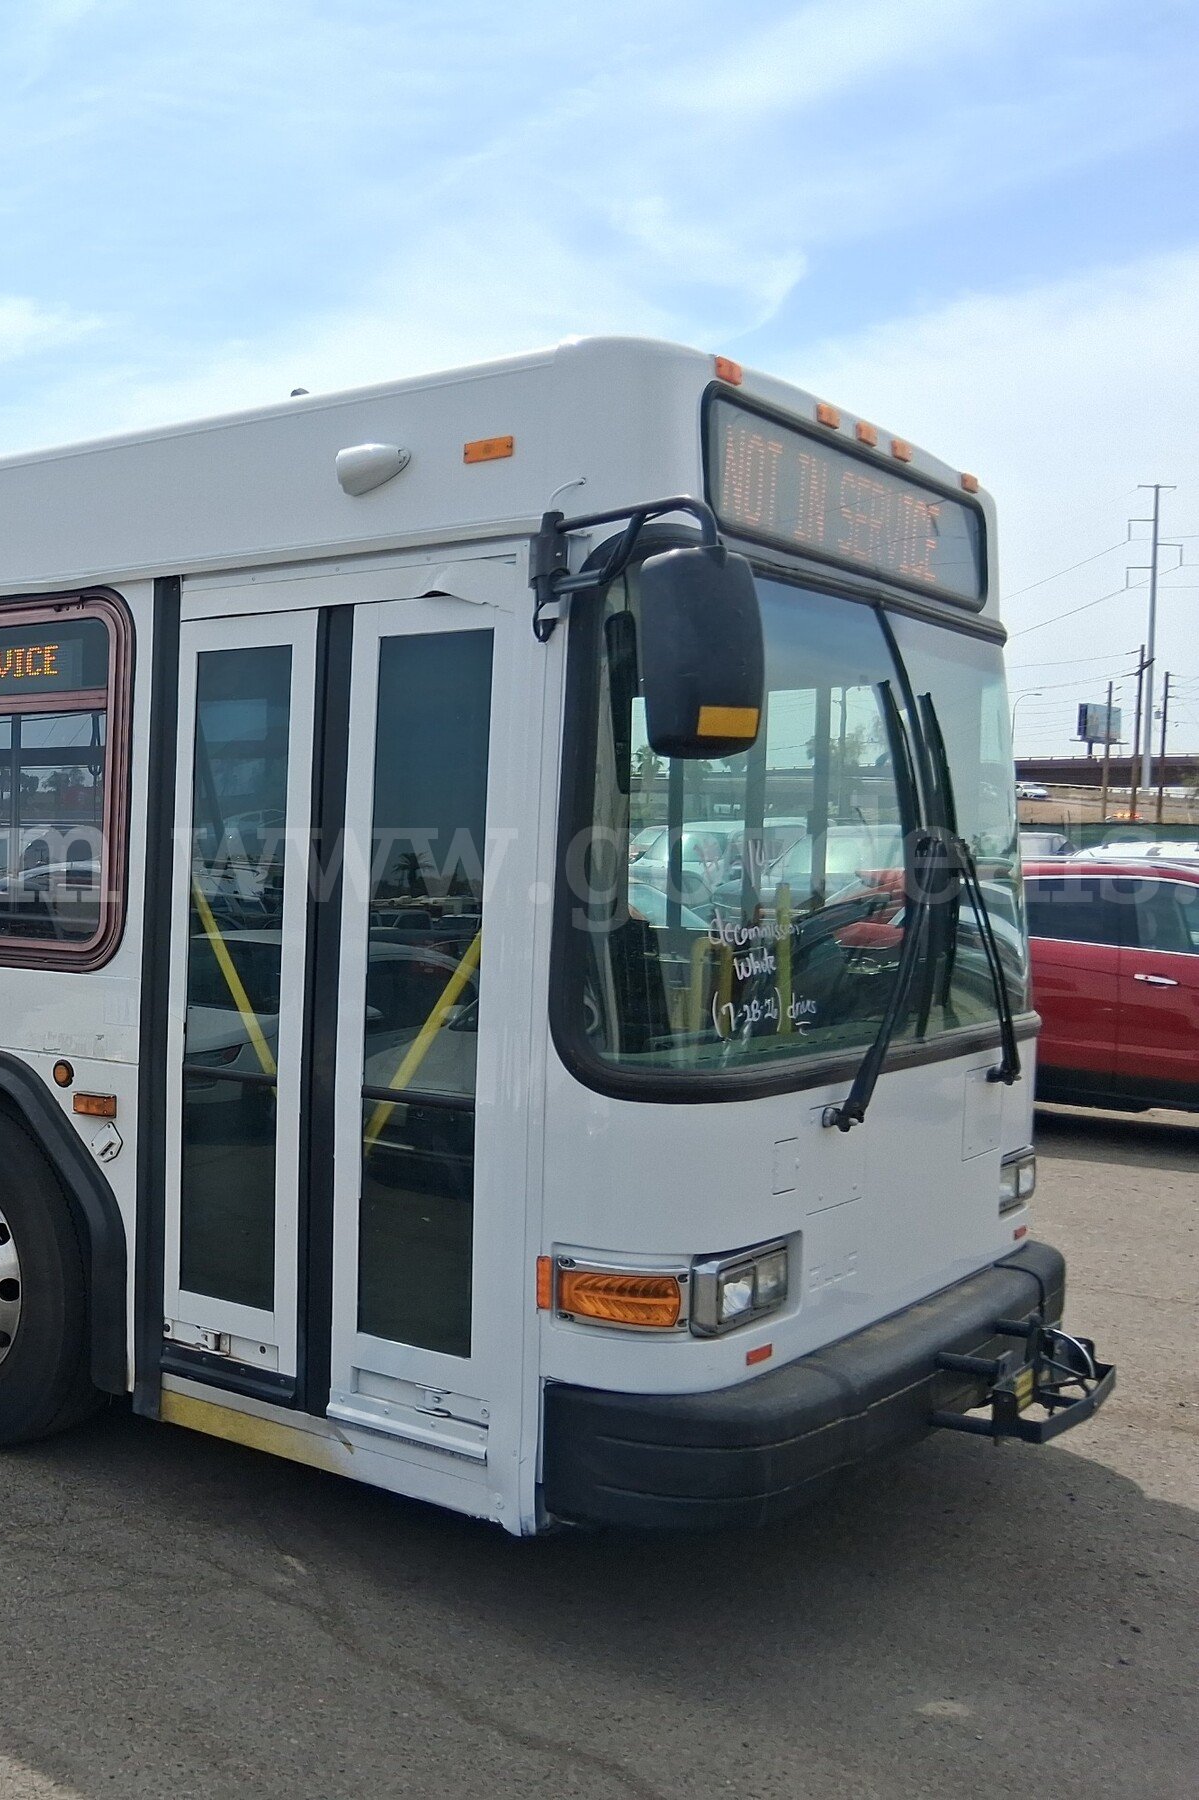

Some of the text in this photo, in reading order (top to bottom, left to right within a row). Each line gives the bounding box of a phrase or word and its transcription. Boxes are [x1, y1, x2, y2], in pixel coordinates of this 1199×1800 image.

[723, 425, 941, 583] NOT IN SERVICE
